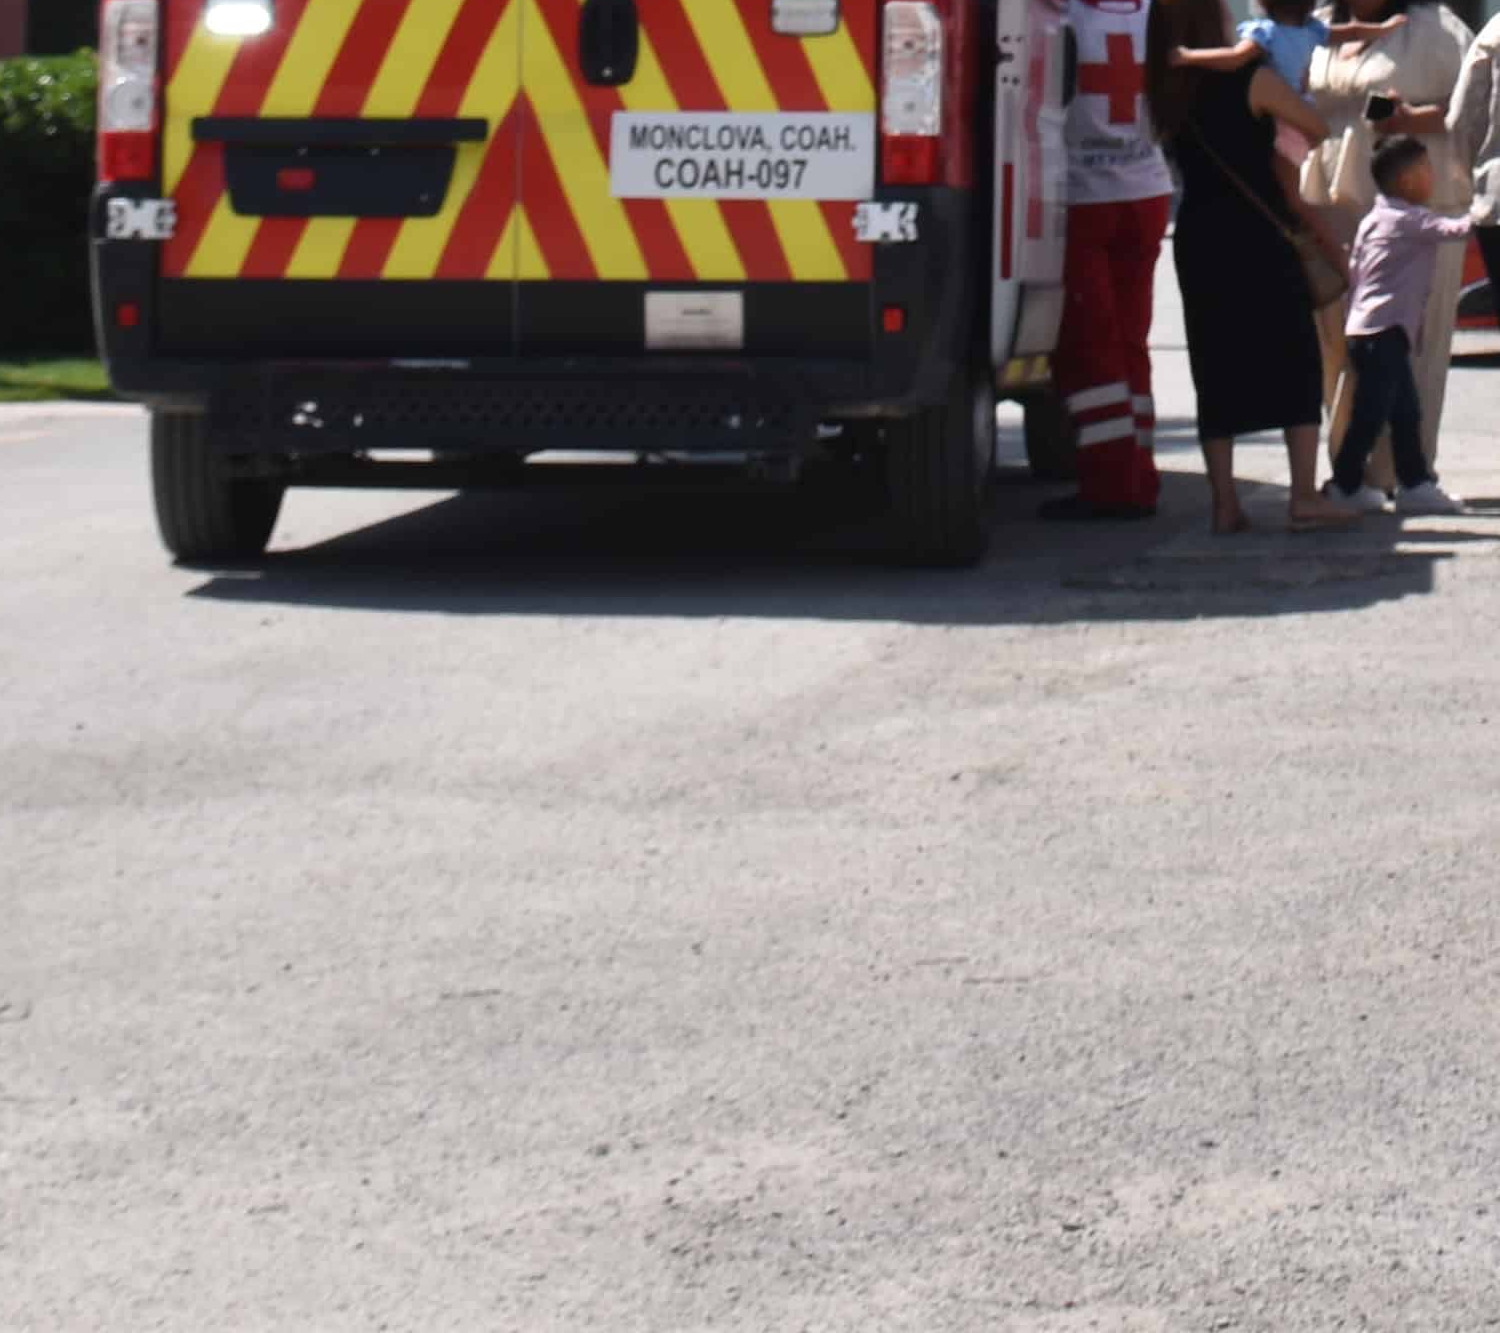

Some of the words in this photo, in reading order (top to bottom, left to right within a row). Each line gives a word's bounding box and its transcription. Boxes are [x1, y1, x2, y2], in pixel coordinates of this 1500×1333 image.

[629, 125, 772, 152] MONCLOVA,
[780, 125, 857, 151] COAH.
[654, 158, 807, 189] COAH-097
